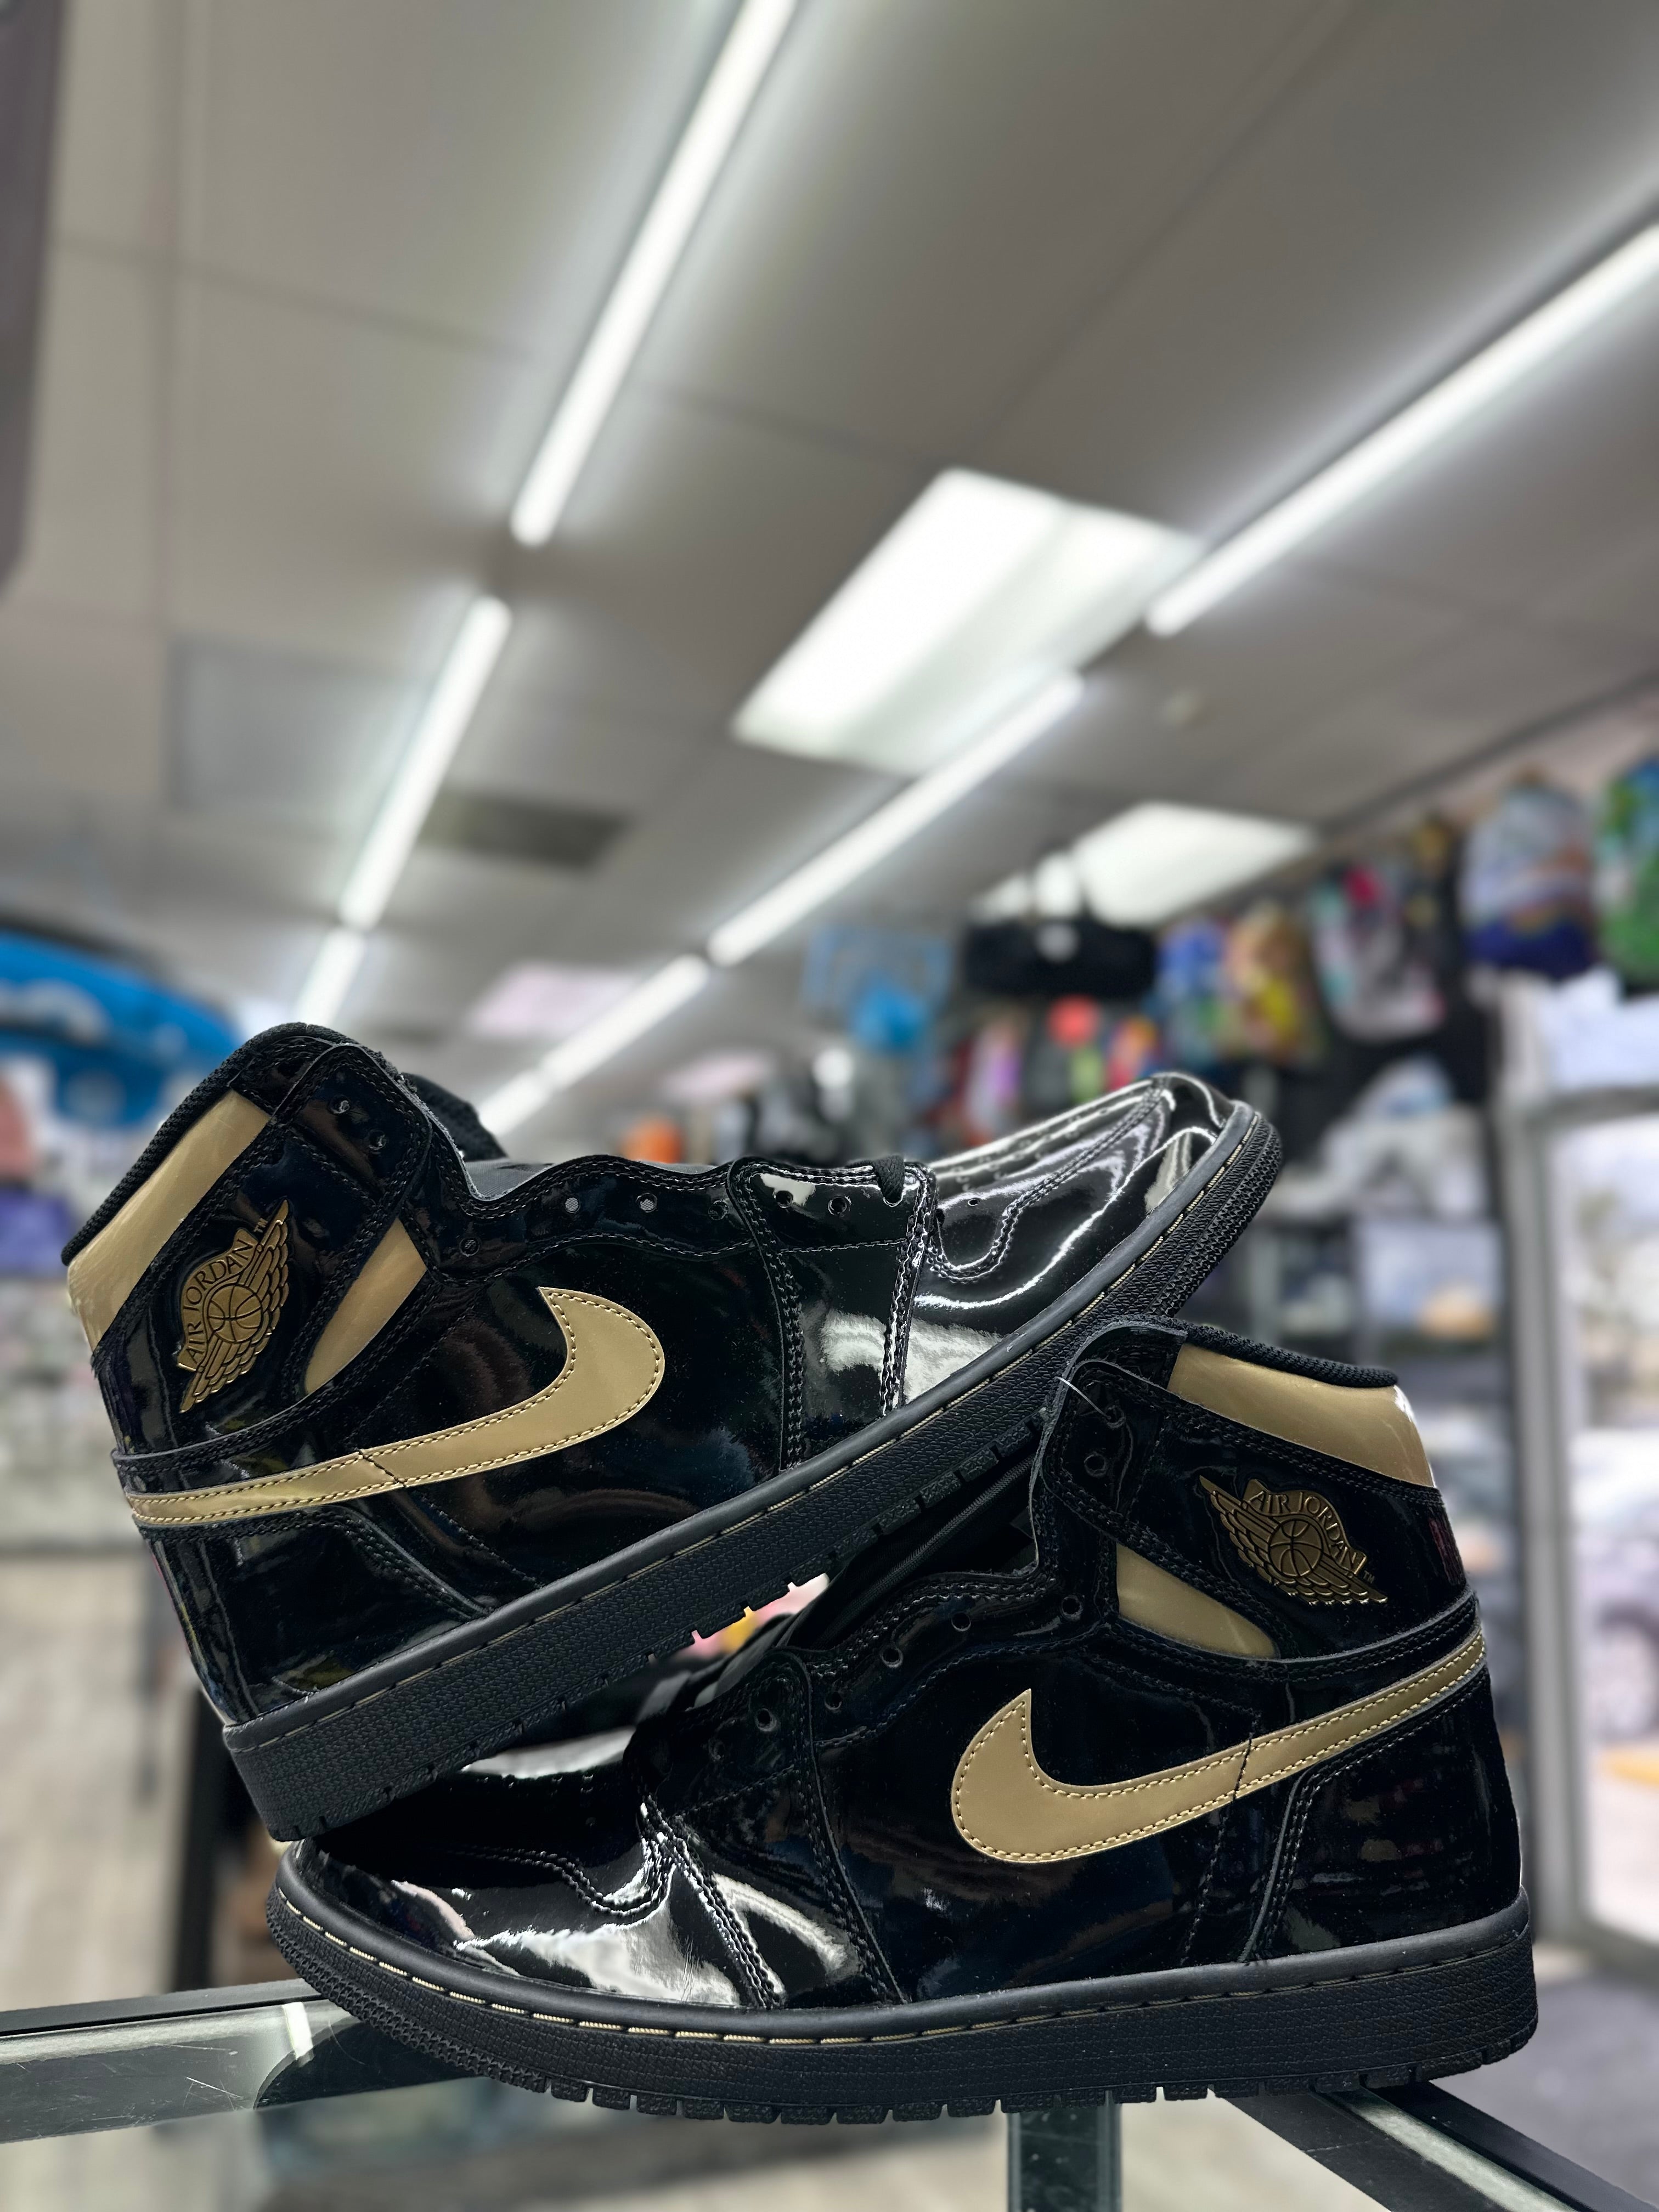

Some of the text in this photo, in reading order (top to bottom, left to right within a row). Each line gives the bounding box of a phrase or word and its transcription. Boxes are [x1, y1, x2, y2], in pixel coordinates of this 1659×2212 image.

[254, 1218, 268, 1233] TM
[183, 1238, 254, 1364] AIR JORDAN
[1248, 1491, 1357, 1570] AIR JORDAN
[1363, 1570, 1375, 1584] TM
